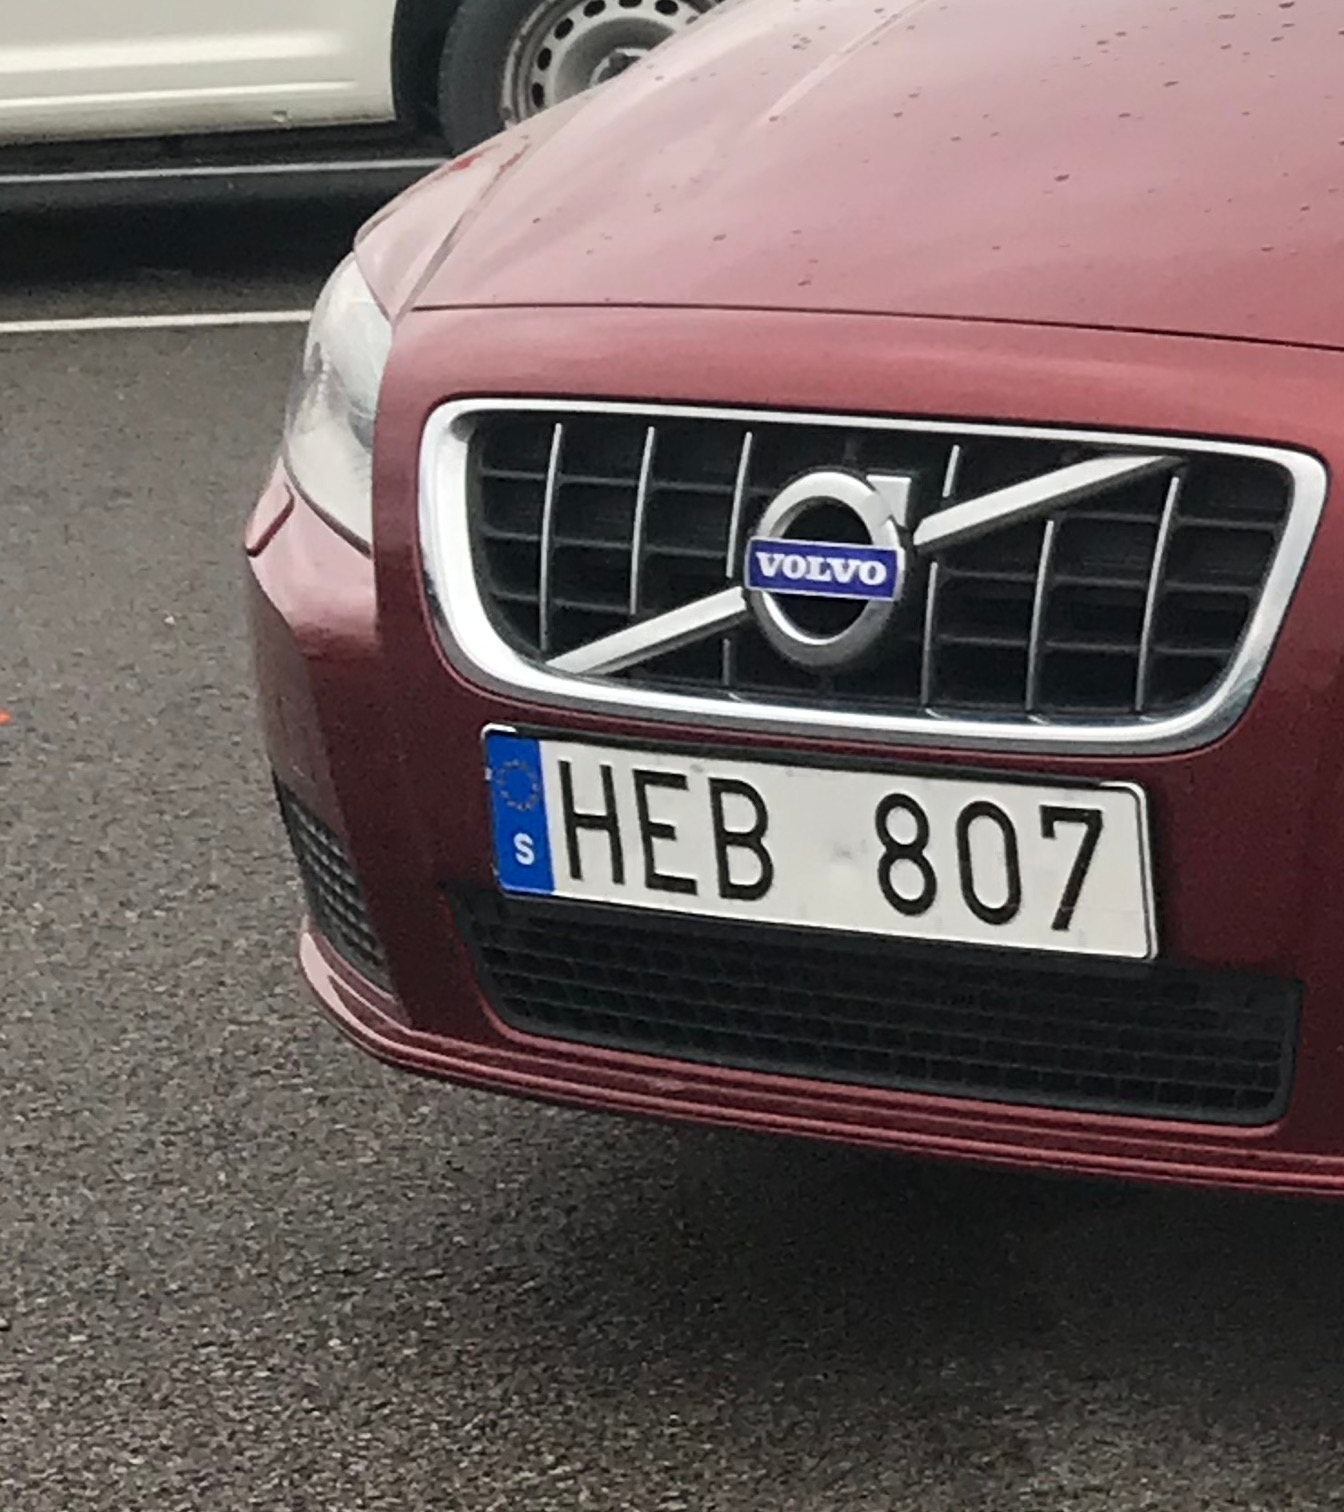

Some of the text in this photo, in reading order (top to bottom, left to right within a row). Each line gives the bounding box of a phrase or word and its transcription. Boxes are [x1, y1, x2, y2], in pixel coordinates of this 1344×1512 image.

[755, 550, 889, 587] VOLVO
[512, 831, 536, 866] S
[557, 759, 1105, 932] HEB 807
